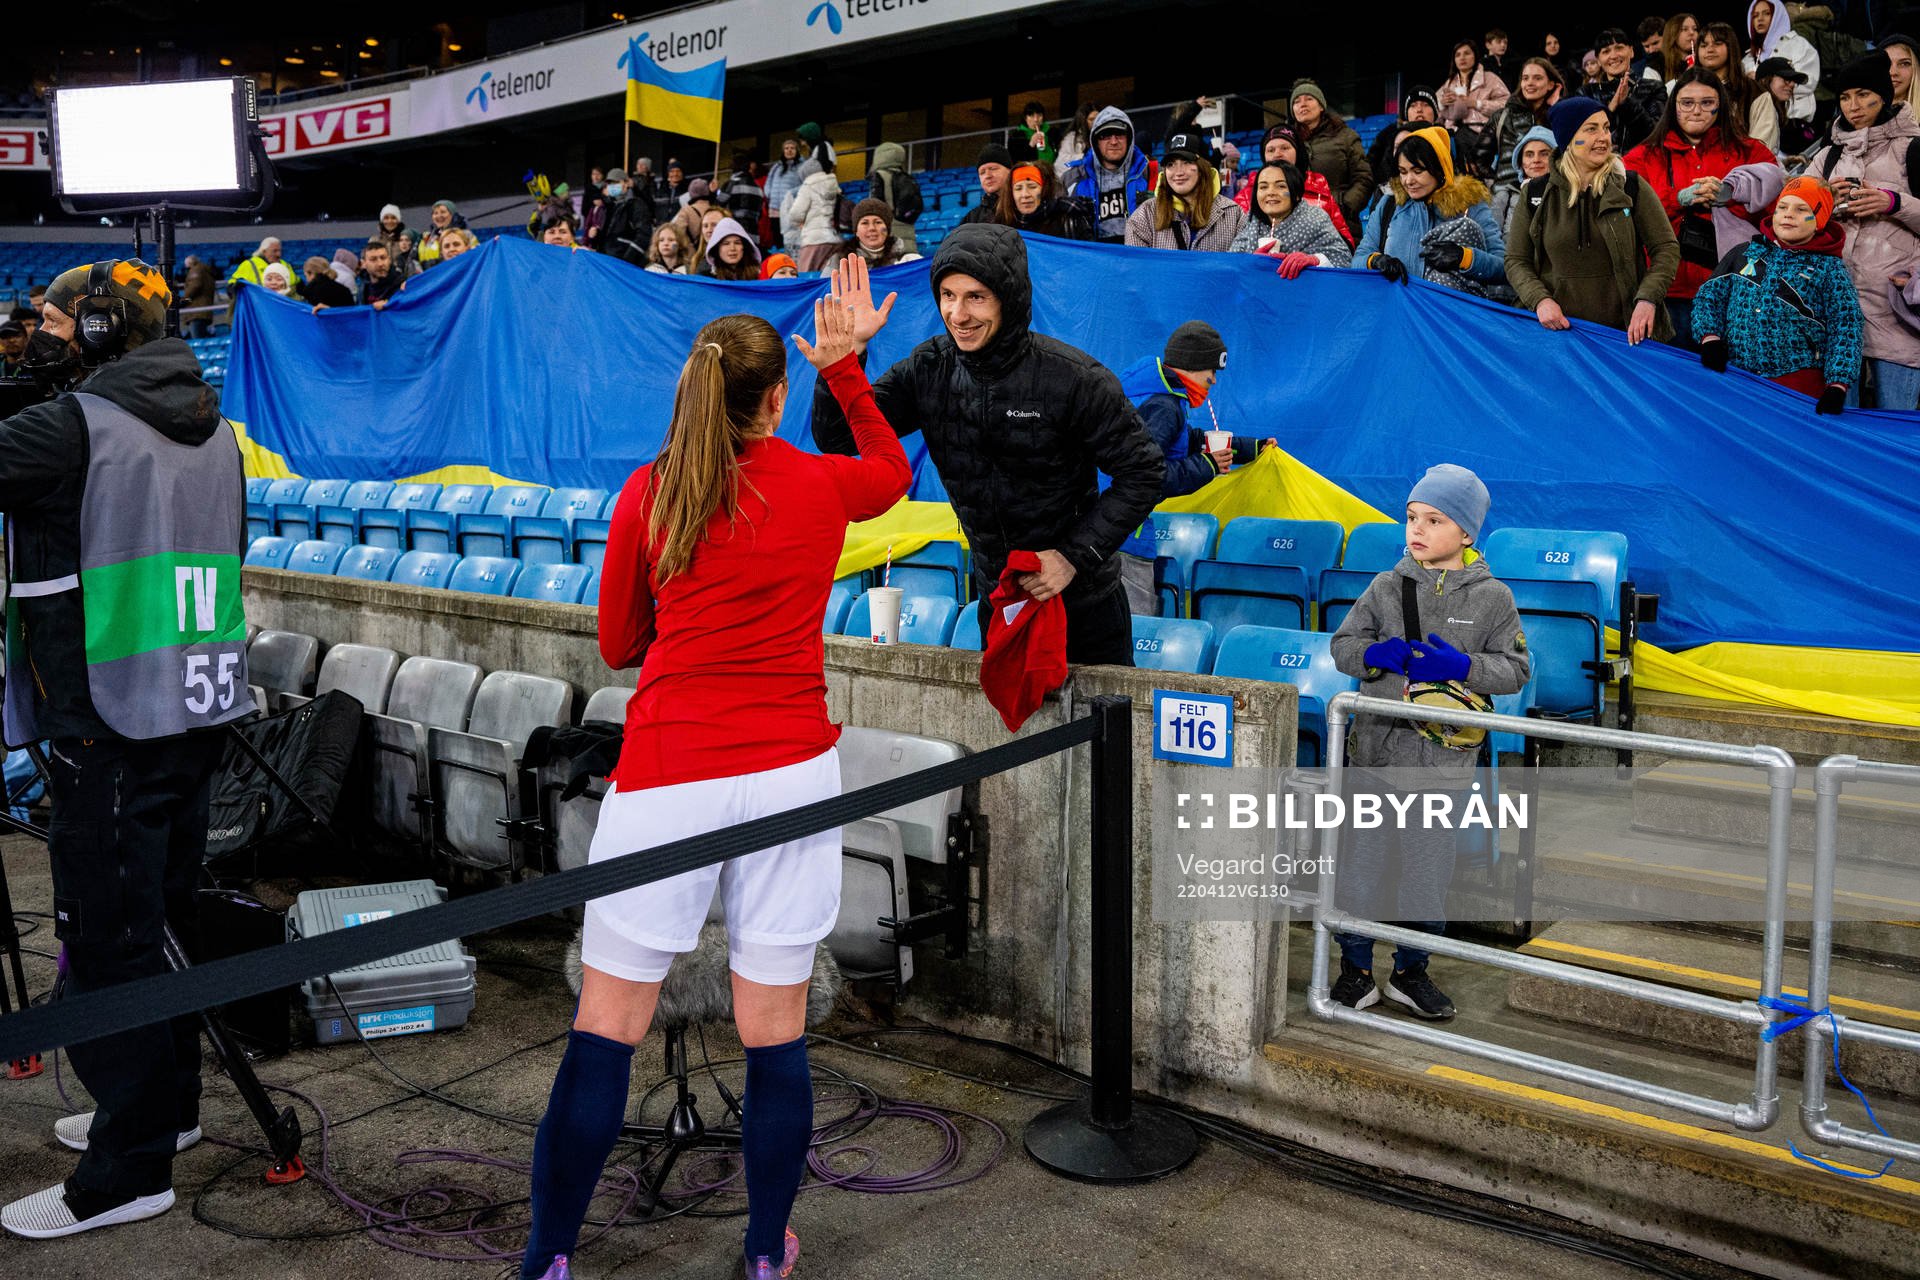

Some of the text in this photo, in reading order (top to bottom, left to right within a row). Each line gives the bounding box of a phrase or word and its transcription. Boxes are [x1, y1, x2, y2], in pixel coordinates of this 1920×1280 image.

[648, 26, 727, 62] telenor
[490, 68, 555, 100] telenor
[298, 103, 386, 146] VG
[1012, 410, 1041, 418] Columbia
[1273, 538, 1294, 550] 626
[1544, 551, 1570, 564] 628
[1135, 639, 1159, 651] 626
[1280, 654, 1306, 667] 627
[185, 652, 239, 714] 55
[1179, 703, 1208, 717] FELT
[1169, 716, 1217, 751] 116
[360, 1014, 382, 1024] nrk
